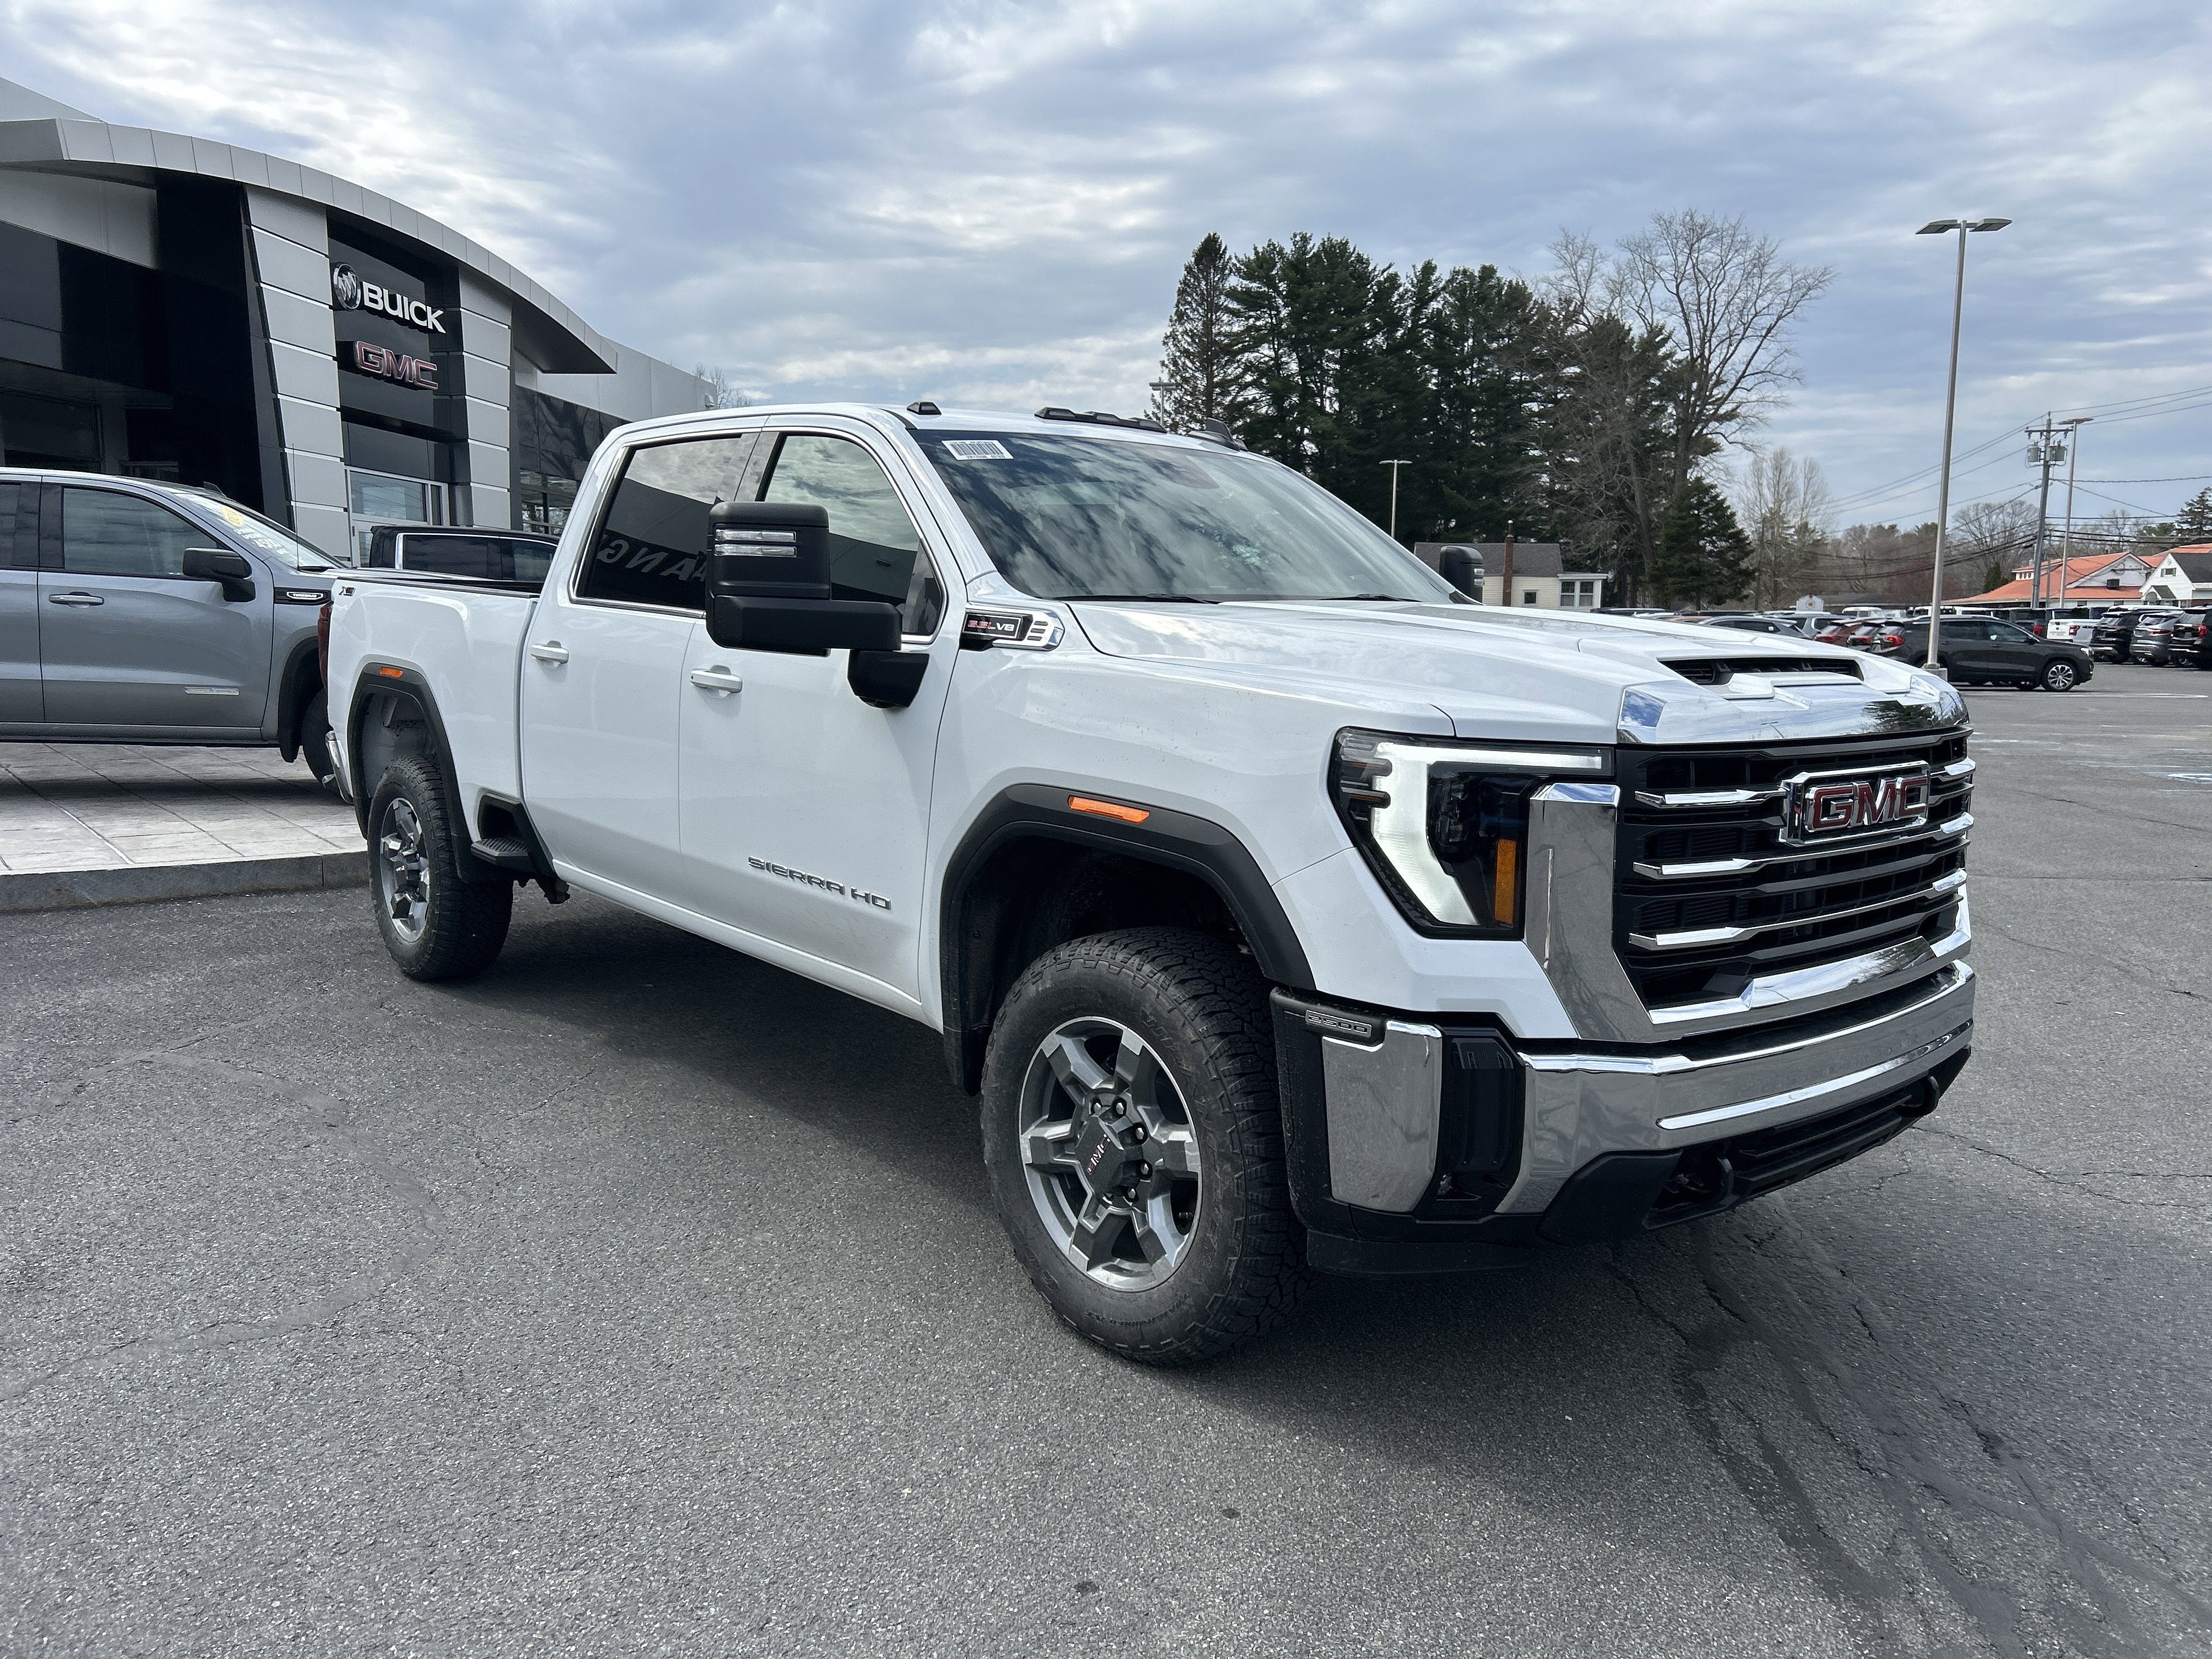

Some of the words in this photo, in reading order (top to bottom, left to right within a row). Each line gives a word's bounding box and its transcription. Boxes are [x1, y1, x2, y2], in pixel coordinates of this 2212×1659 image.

[363, 281, 446, 334] BUICK
[356, 341, 438, 390] GMC
[1805, 776, 1928, 833] GMC
[748, 856, 845, 895] SIERRA
[850, 886, 891, 910] HD
[1307, 1014, 1369, 1034] 2500
